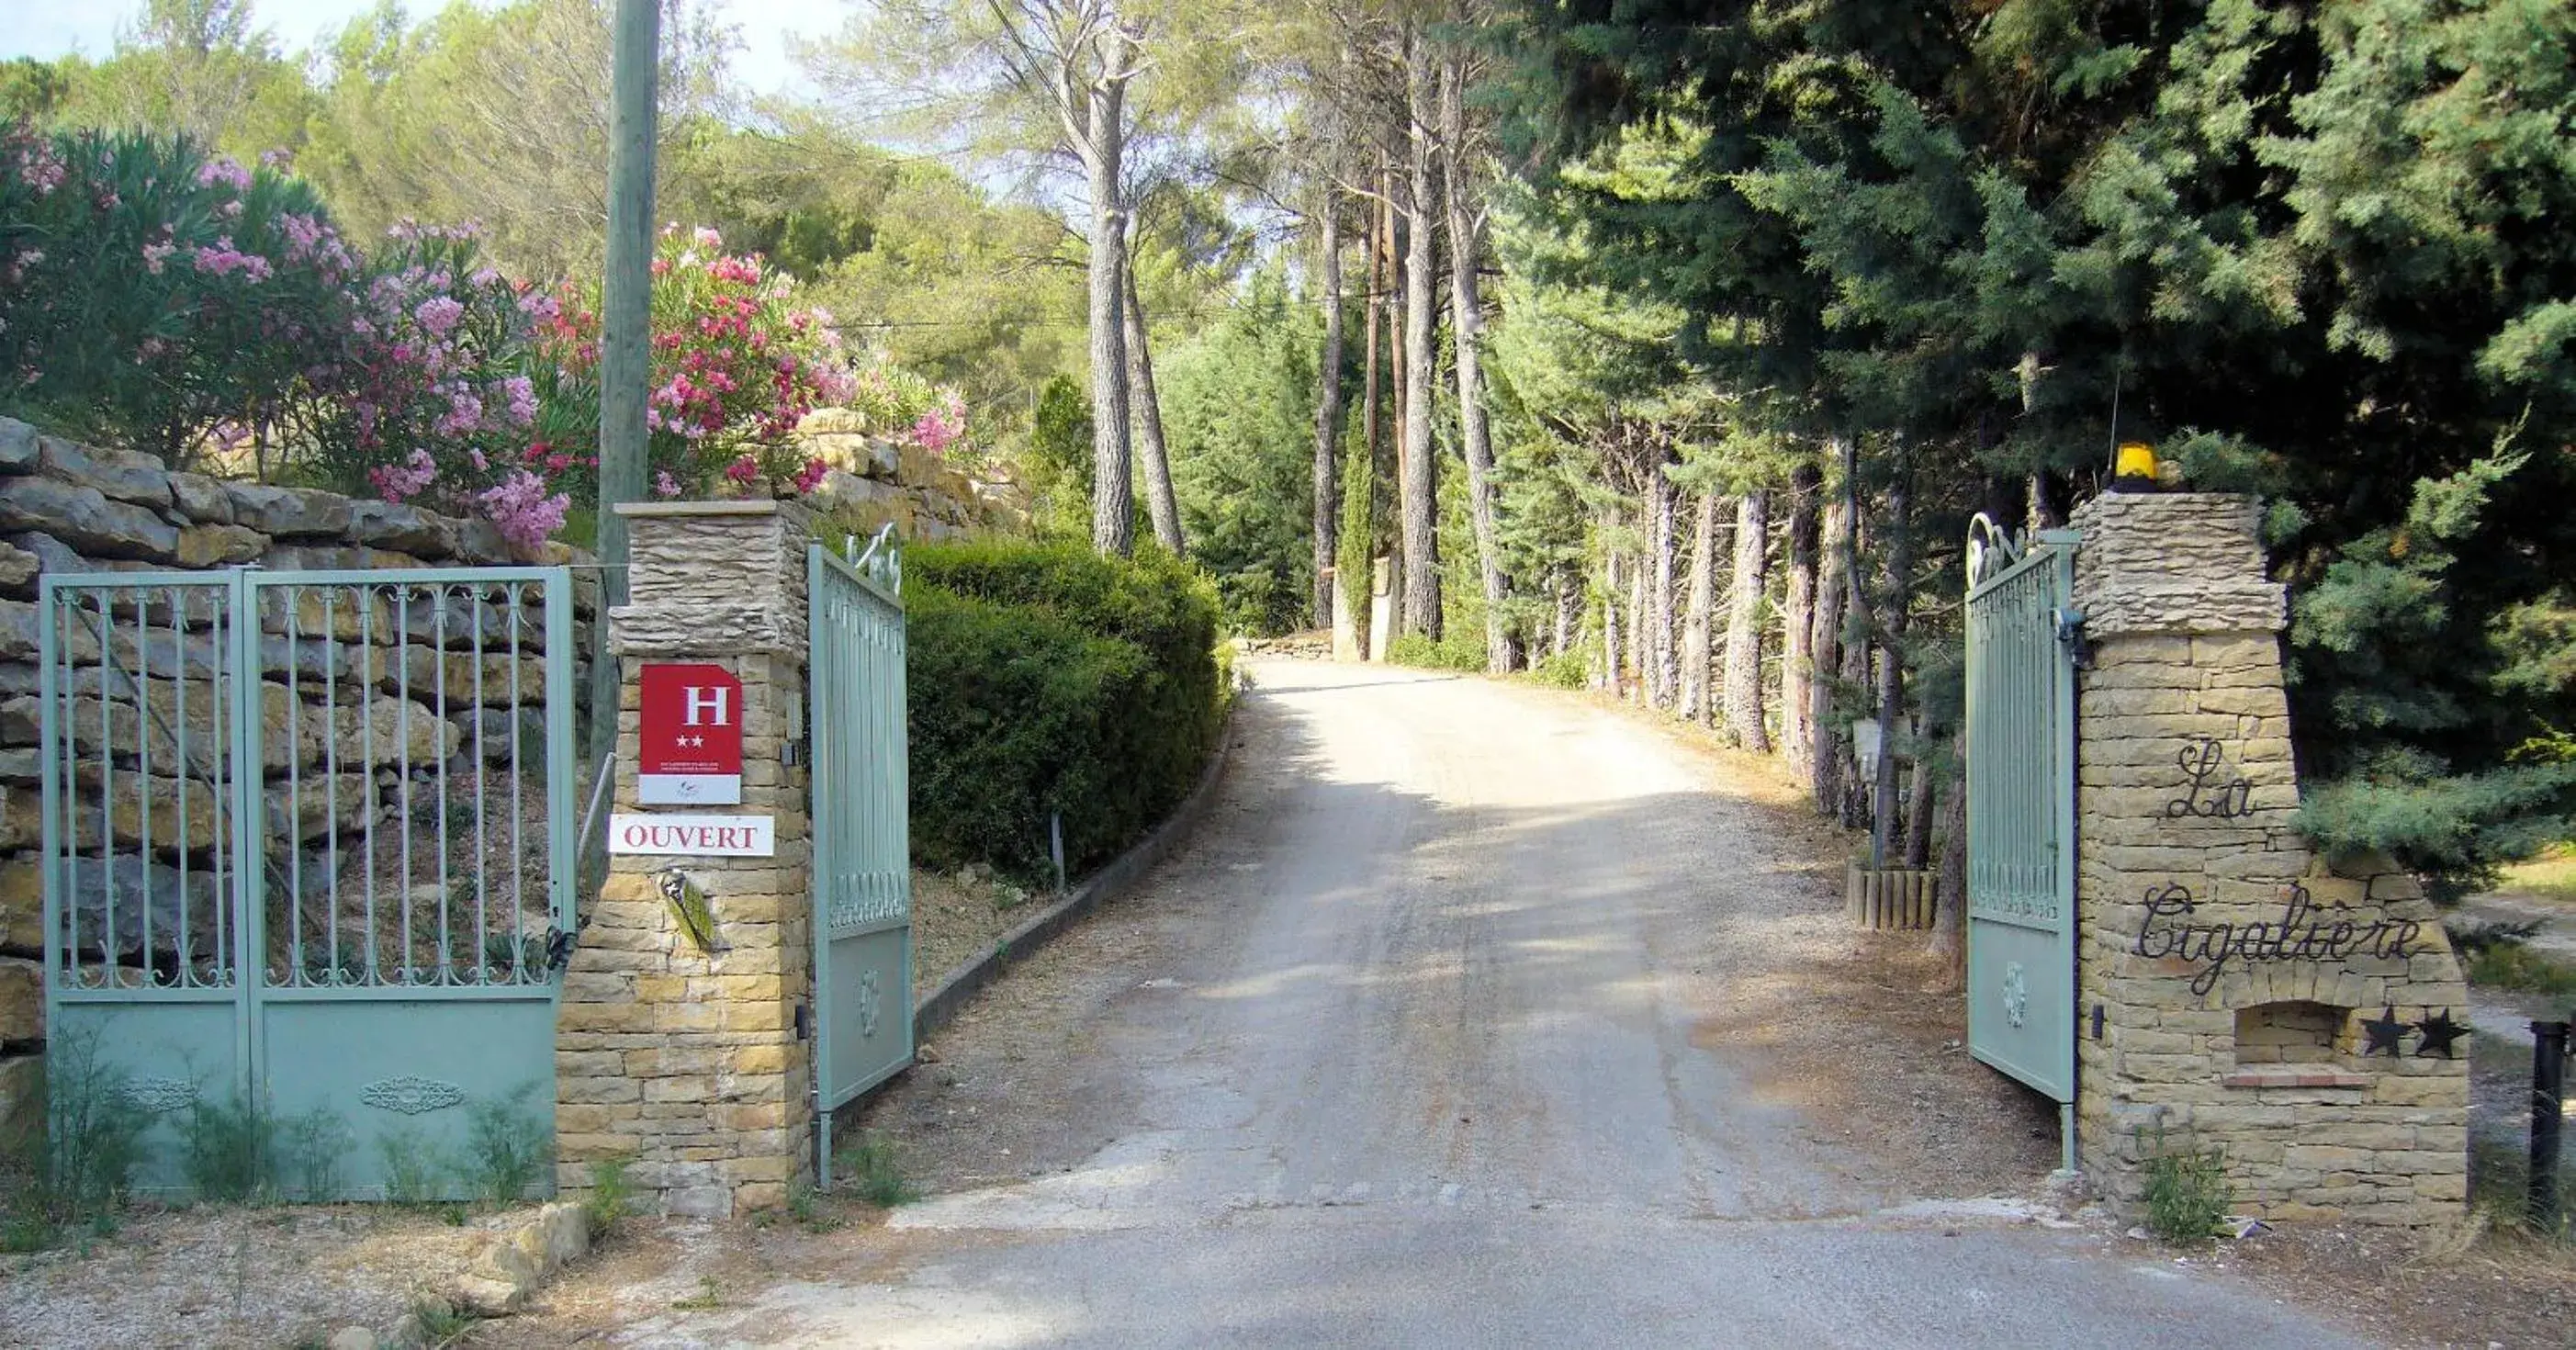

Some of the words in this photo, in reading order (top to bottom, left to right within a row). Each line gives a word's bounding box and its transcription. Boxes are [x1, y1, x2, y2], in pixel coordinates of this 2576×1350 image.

[682, 686, 732, 726] H
[2166, 739, 2256, 818] La
[624, 825, 758, 849] OUVERT
